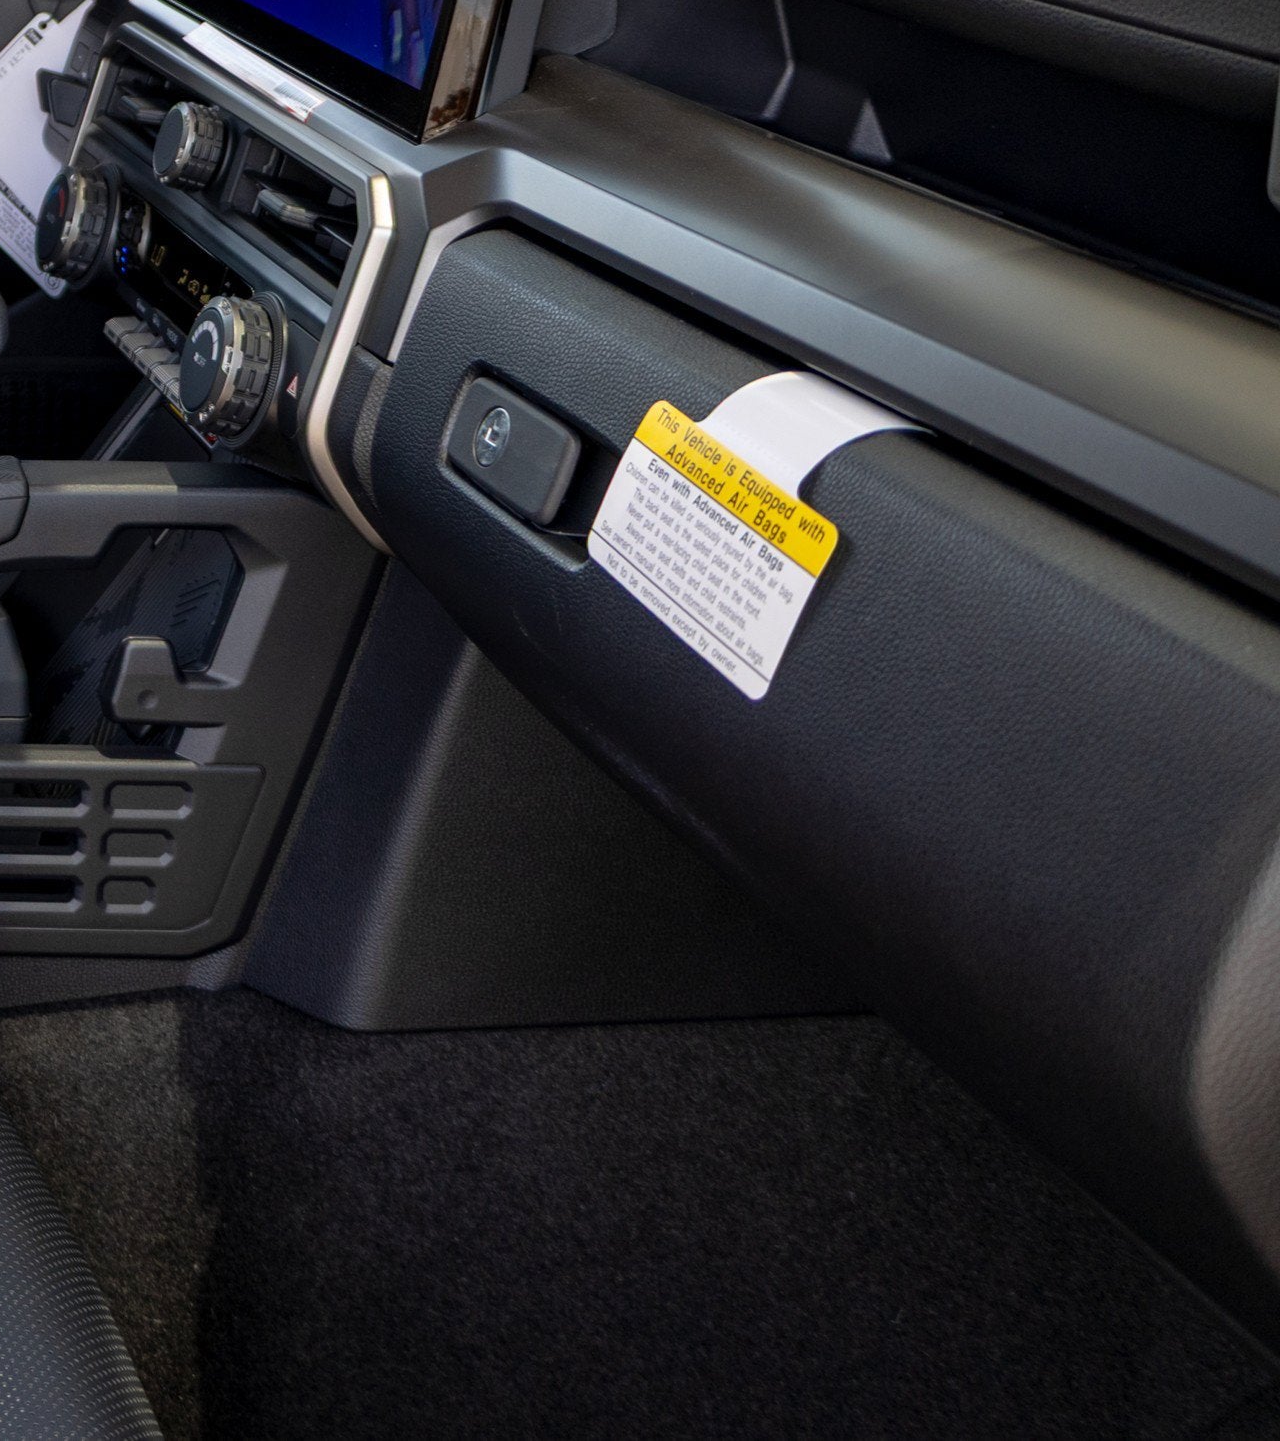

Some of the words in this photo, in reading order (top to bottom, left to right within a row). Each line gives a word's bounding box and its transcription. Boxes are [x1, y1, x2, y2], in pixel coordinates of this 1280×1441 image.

[647, 457, 670, 482] Even
[671, 478, 691, 499] with
[692, 494, 739, 536] Advanced
[738, 531, 756, 549] Air
[757, 544, 784, 572] Bags
[656, 407, 680, 434] This
[683, 427, 722, 466] Vehicle
[723, 458, 737, 477] is
[738, 470, 797, 520] Equipped
[797, 516, 825, 544] with
[665, 444, 726, 495] Advanced
[726, 491, 749, 514] Air
[752, 508, 787, 544] Bags
[605, 552, 619, 571] Not
[619, 565, 628, 579] to
[627, 573, 639, 589] be
[639, 585, 671, 617] removed
[671, 613, 697, 640] except
[697, 634, 710, 652] by
